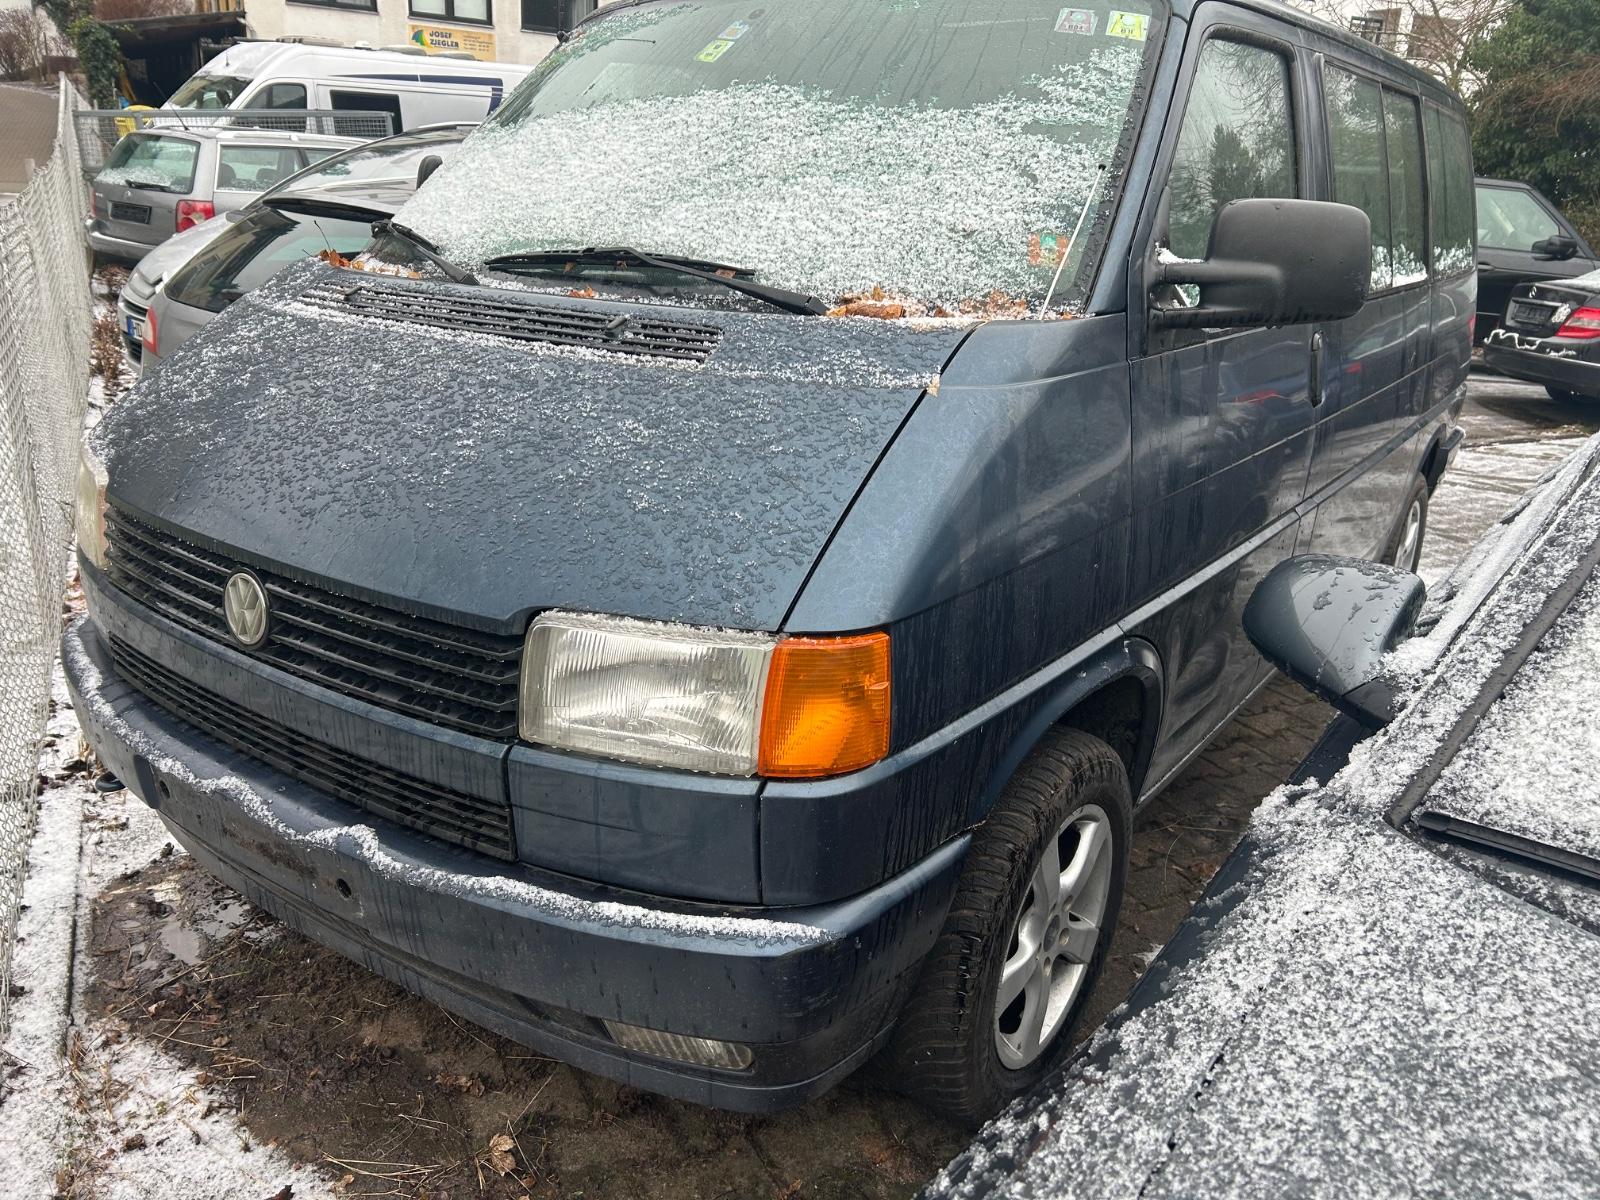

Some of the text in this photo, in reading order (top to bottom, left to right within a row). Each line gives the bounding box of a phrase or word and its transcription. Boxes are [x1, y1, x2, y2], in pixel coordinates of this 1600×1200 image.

[429, 30, 453, 39] JOSEF
[429, 38, 459, 48] ZIEGLER
[225, 573, 266, 645] VW
